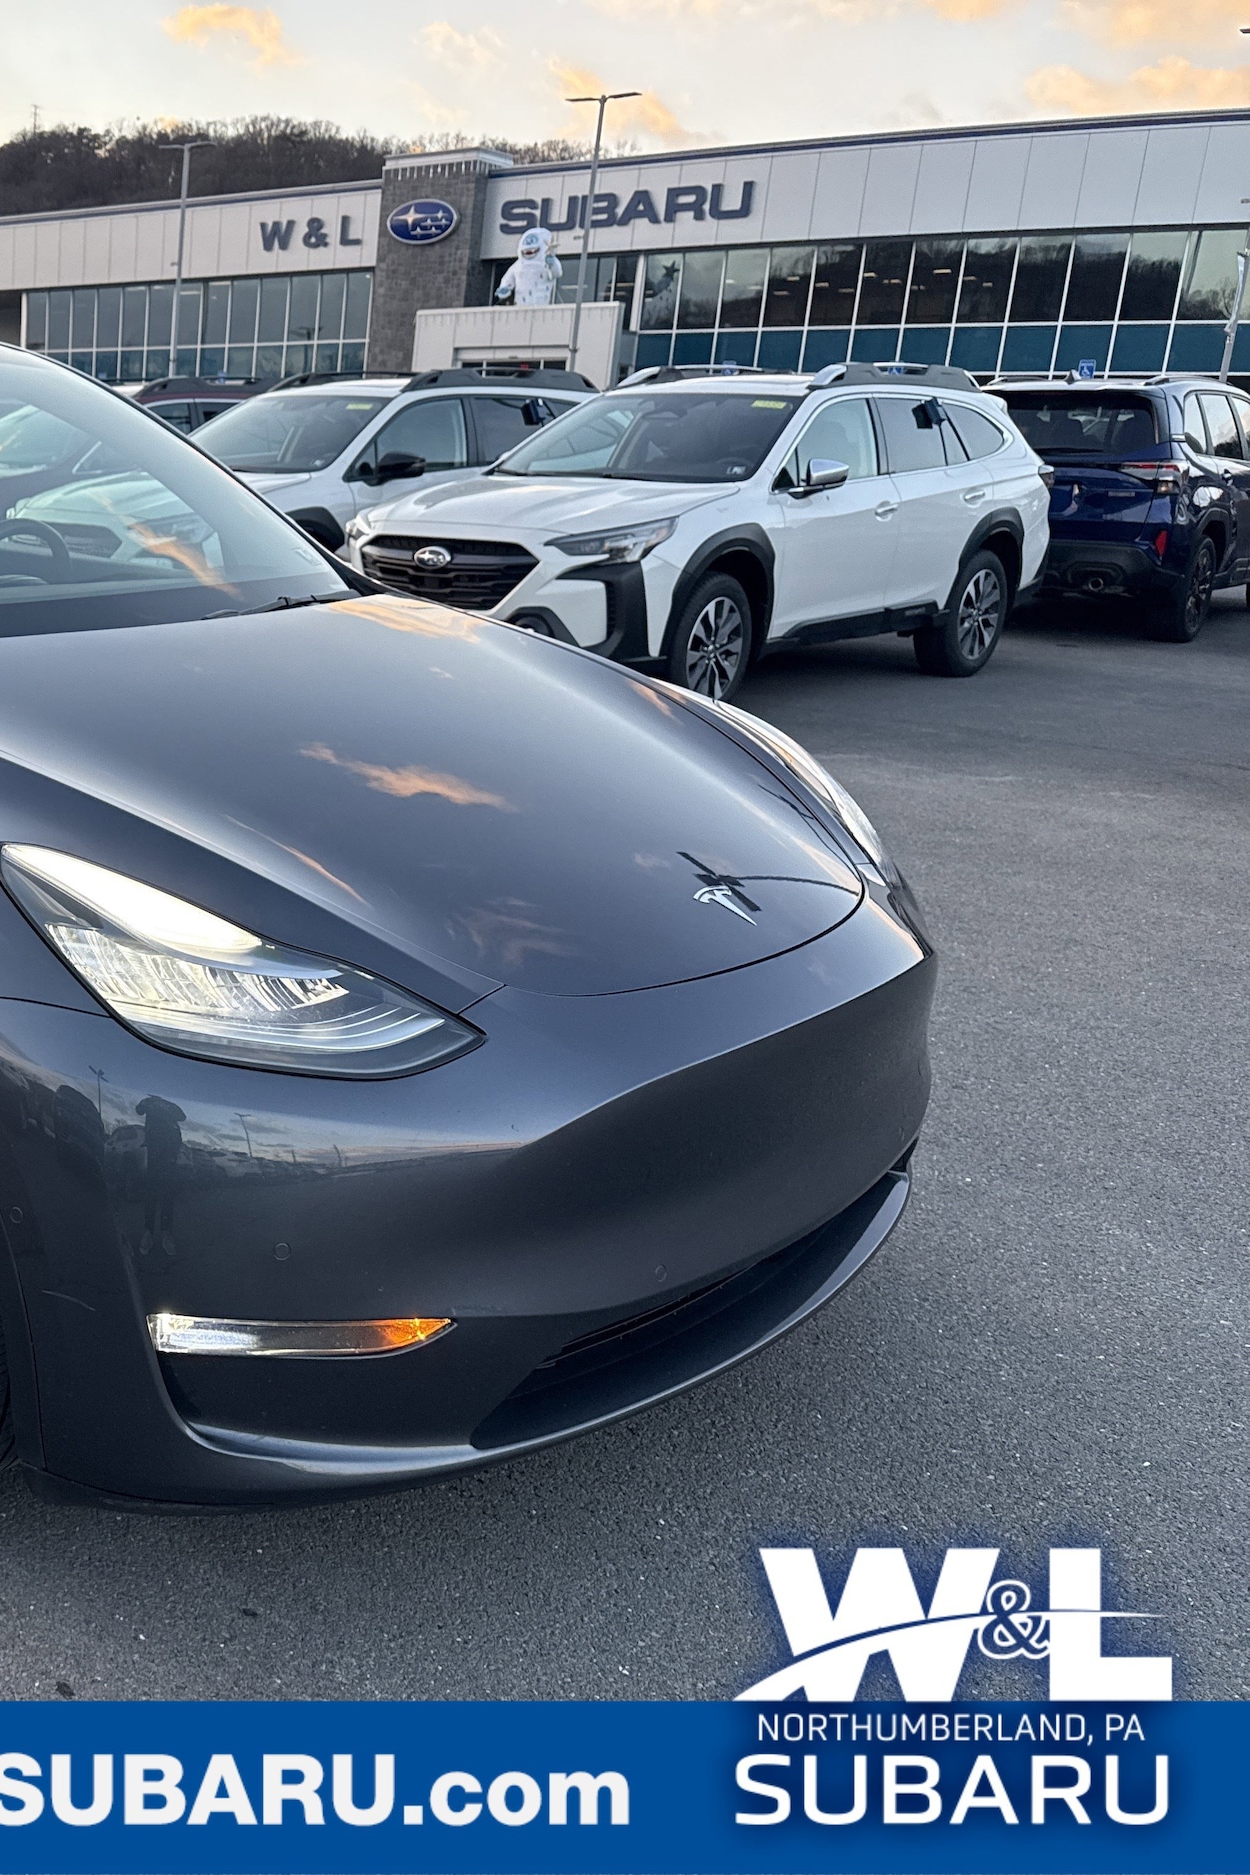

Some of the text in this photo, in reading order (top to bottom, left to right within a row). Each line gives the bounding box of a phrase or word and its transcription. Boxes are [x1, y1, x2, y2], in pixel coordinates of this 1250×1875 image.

[499, 180, 755, 236] SUBARU
[259, 214, 363, 252] W & L
